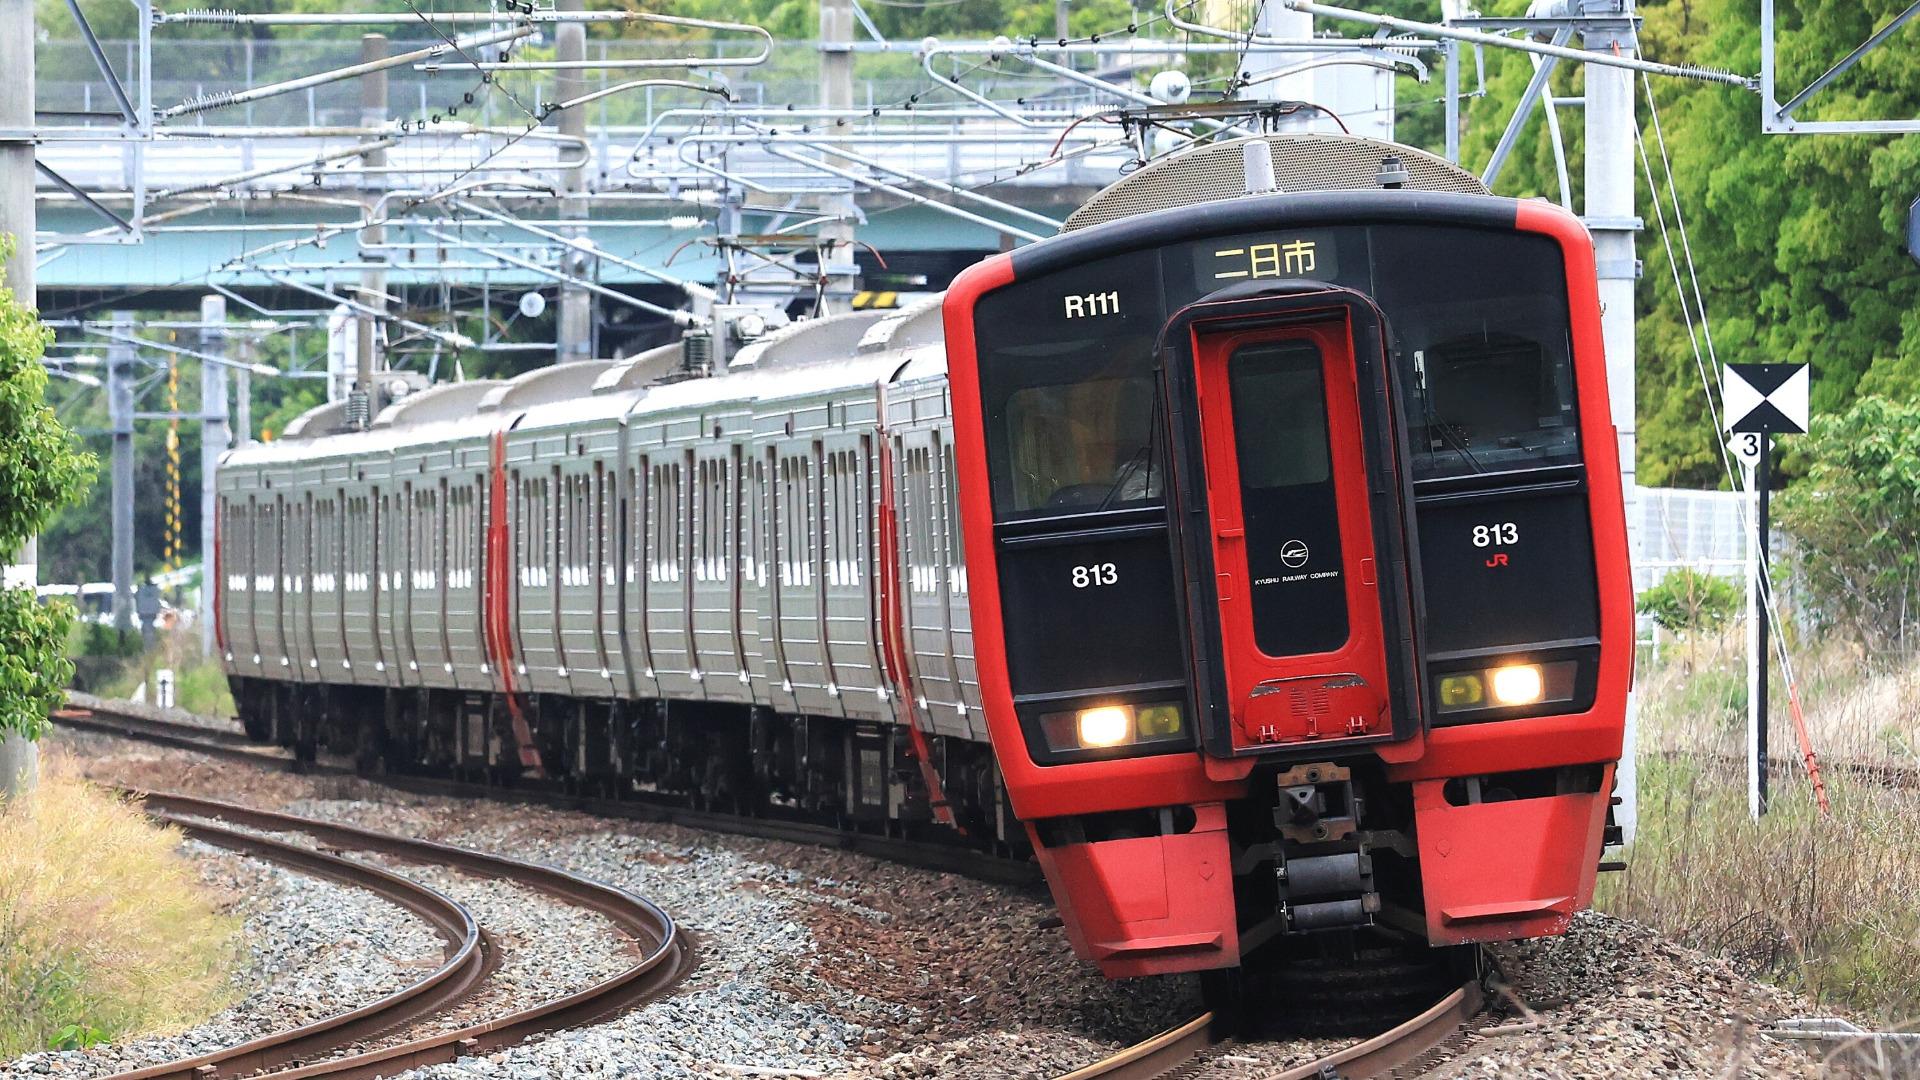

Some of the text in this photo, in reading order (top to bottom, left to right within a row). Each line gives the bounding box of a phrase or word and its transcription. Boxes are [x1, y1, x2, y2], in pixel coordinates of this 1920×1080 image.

[1215, 240, 1315, 278] 二日市
[1064, 291, 1120, 319] R111
[1743, 434, 1758, 456] 3
[1472, 522, 1519, 547] 813
[1486, 553, 1508, 567] JR
[1072, 562, 1118, 588] 813
[1254, 571, 1339, 585] KYUSHU RAILWAY COMPANY
